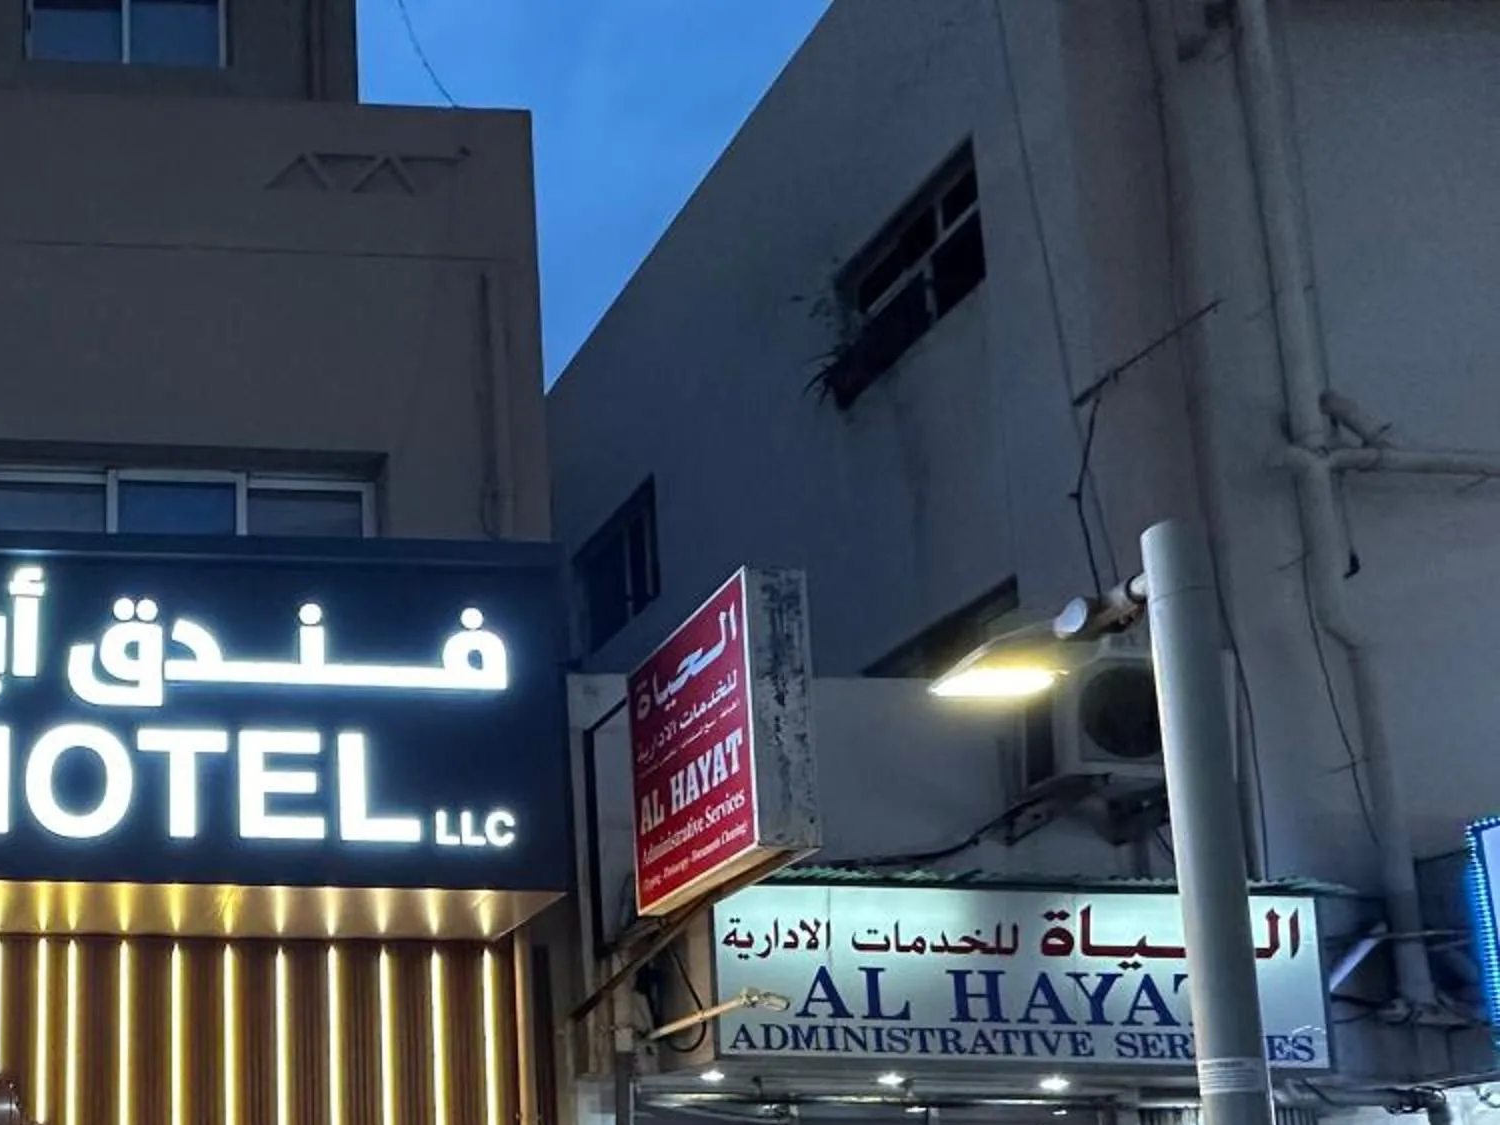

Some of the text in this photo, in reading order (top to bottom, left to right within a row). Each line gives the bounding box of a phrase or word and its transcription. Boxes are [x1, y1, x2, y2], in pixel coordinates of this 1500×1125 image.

[67, 596, 509, 707] فندق
[636, 601, 738, 721] الحياة
[679, 668, 738, 730] للخدمات
[640, 788, 665, 837] AL
[669, 727, 743, 816] HAYAT
[704, 788, 746, 829] Services
[435, 810, 516, 848] LLC
[721, 904, 1301, 970] الياة للخدمات الادارية
[795, 965, 911, 1021] AL
[728, 1023, 1316, 1062] ADMINISTRATIVE SERES
